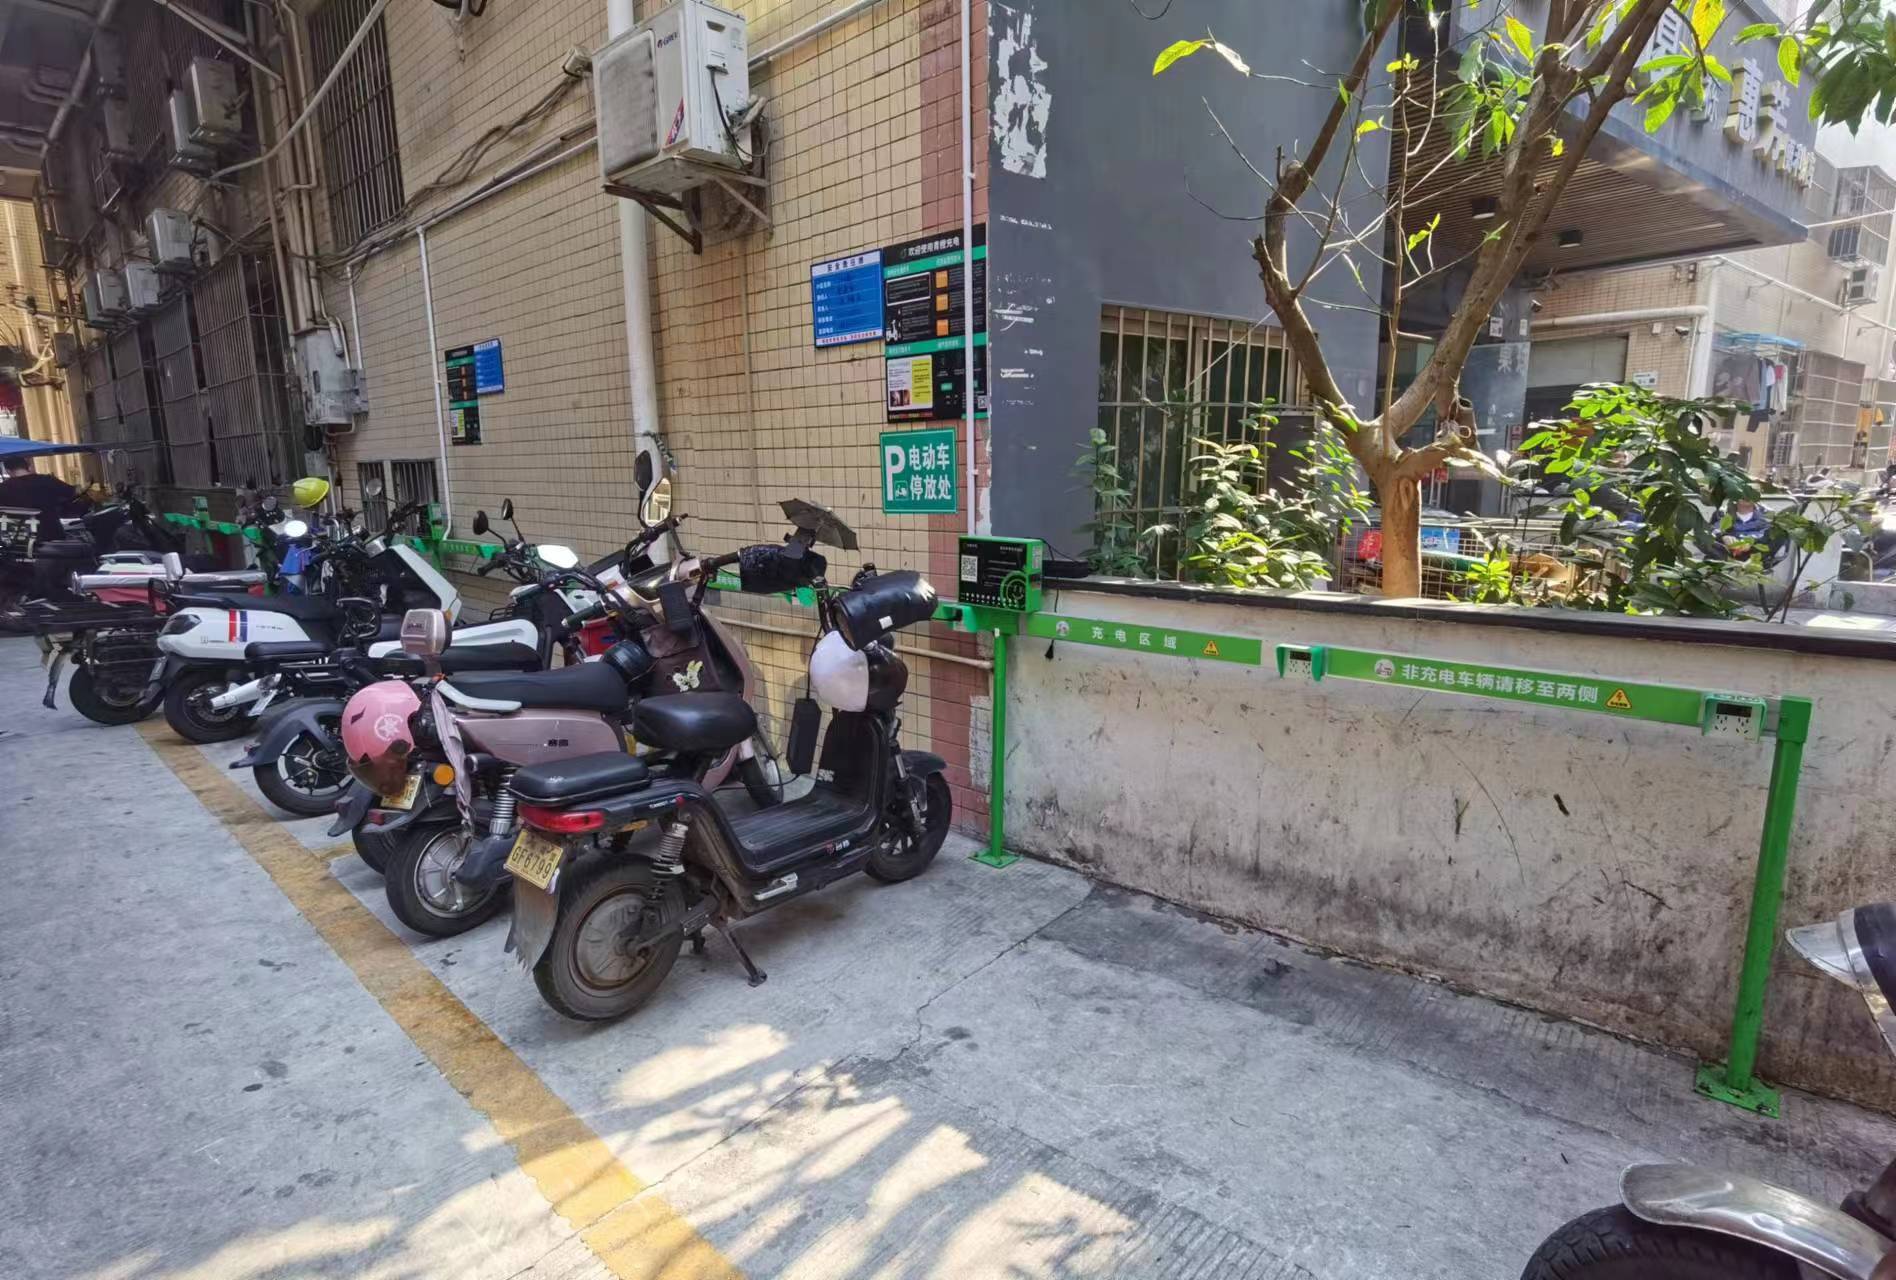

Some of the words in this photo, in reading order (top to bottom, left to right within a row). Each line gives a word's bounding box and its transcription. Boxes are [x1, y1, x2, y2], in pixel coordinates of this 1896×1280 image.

[908, 443, 951, 471] 电动车
[884, 445, 906, 502] P
[910, 474, 952, 501] 停放处
[1091, 626, 1177, 650] 充电区域
[1401, 663, 1599, 704] 非充电车辆请移至两侧
[512, 847, 552, 878] GF6799
